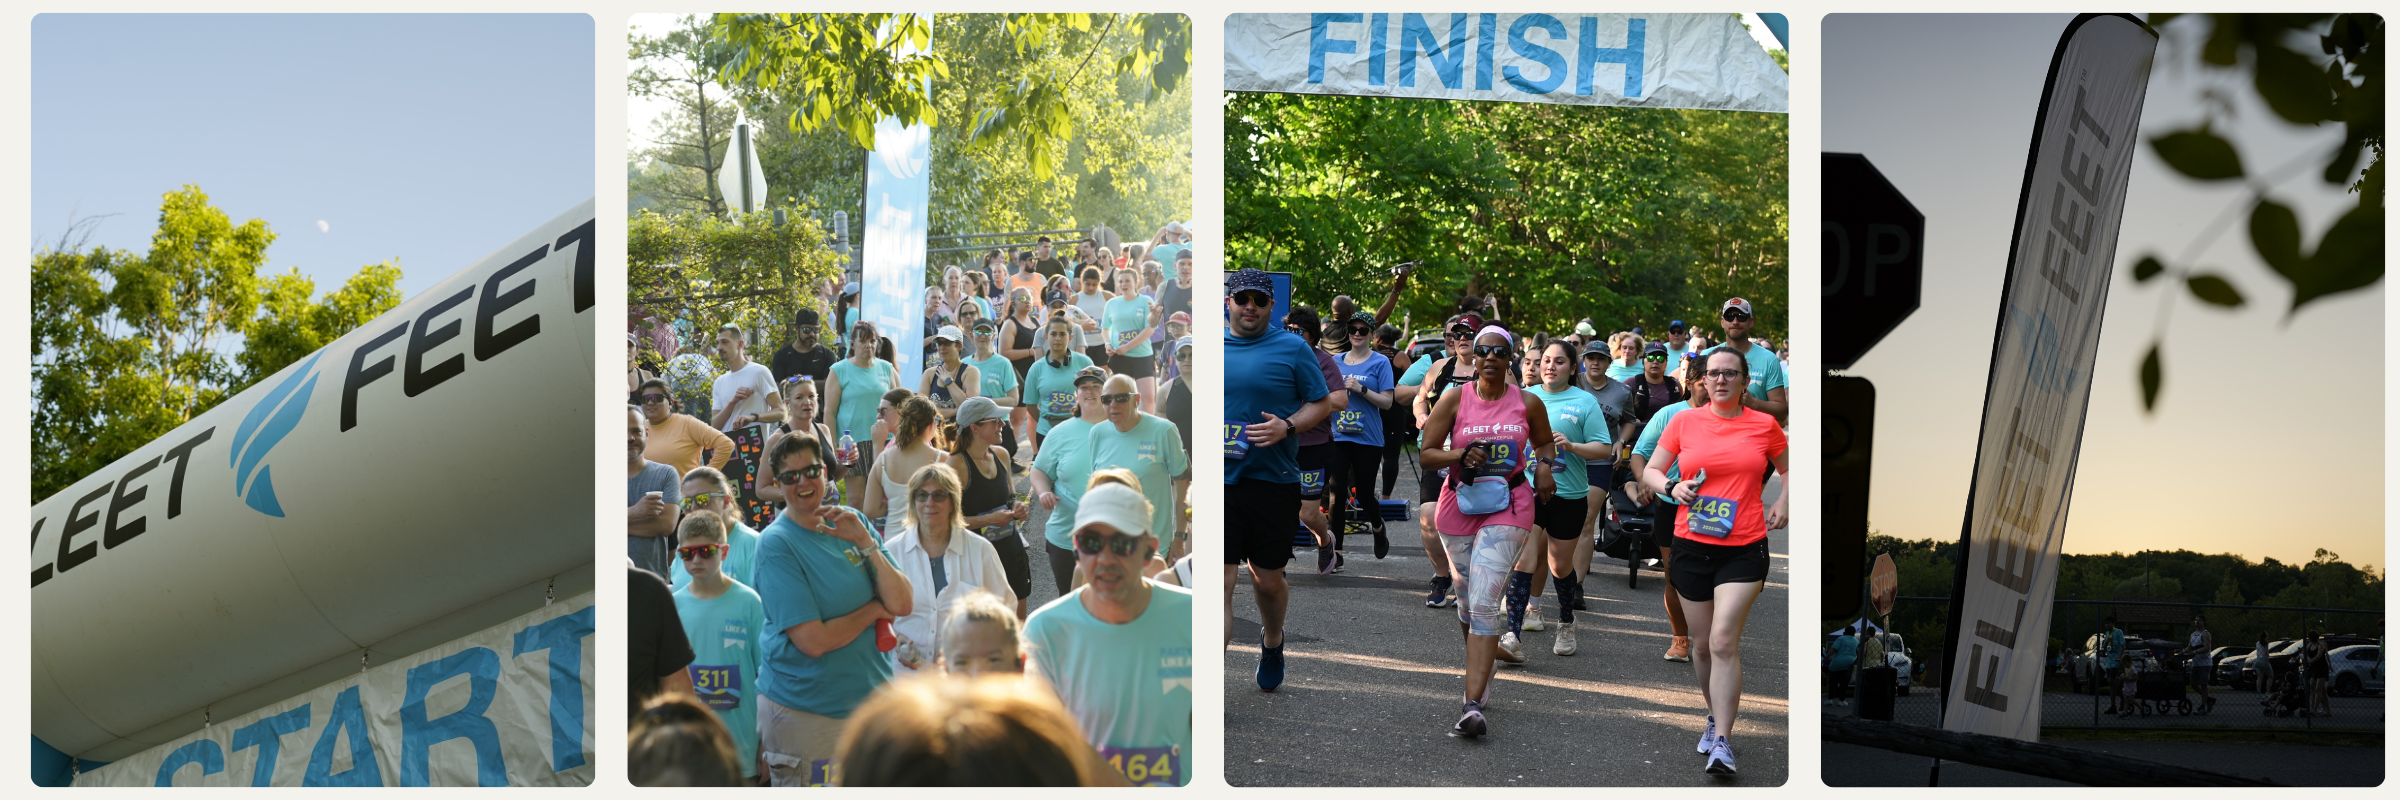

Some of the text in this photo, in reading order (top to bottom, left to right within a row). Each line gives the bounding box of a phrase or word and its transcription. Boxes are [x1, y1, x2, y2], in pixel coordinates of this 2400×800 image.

[1307, 13, 1647, 98] FINISH
[340, 217, 595, 433] FEET
[1119, 331, 1138, 340] 340
[1052, 392, 1074, 402] 350
[1964, 406, 2051, 713] FLEET
[2040, 84, 2110, 306] FEET
[1463, 424, 1523, 436] FLEET FEET
[749, 427, 761, 453] FUN
[738, 435, 755, 489] SPOTTED
[1300, 472, 1320, 483] 187
[1692, 499, 1731, 518] 446
[1873, 571, 1896, 599] STOP
[725, 625, 740, 633] LIKE
[1161, 657, 1184, 667] LIKE
[697, 670, 729, 687] 311
